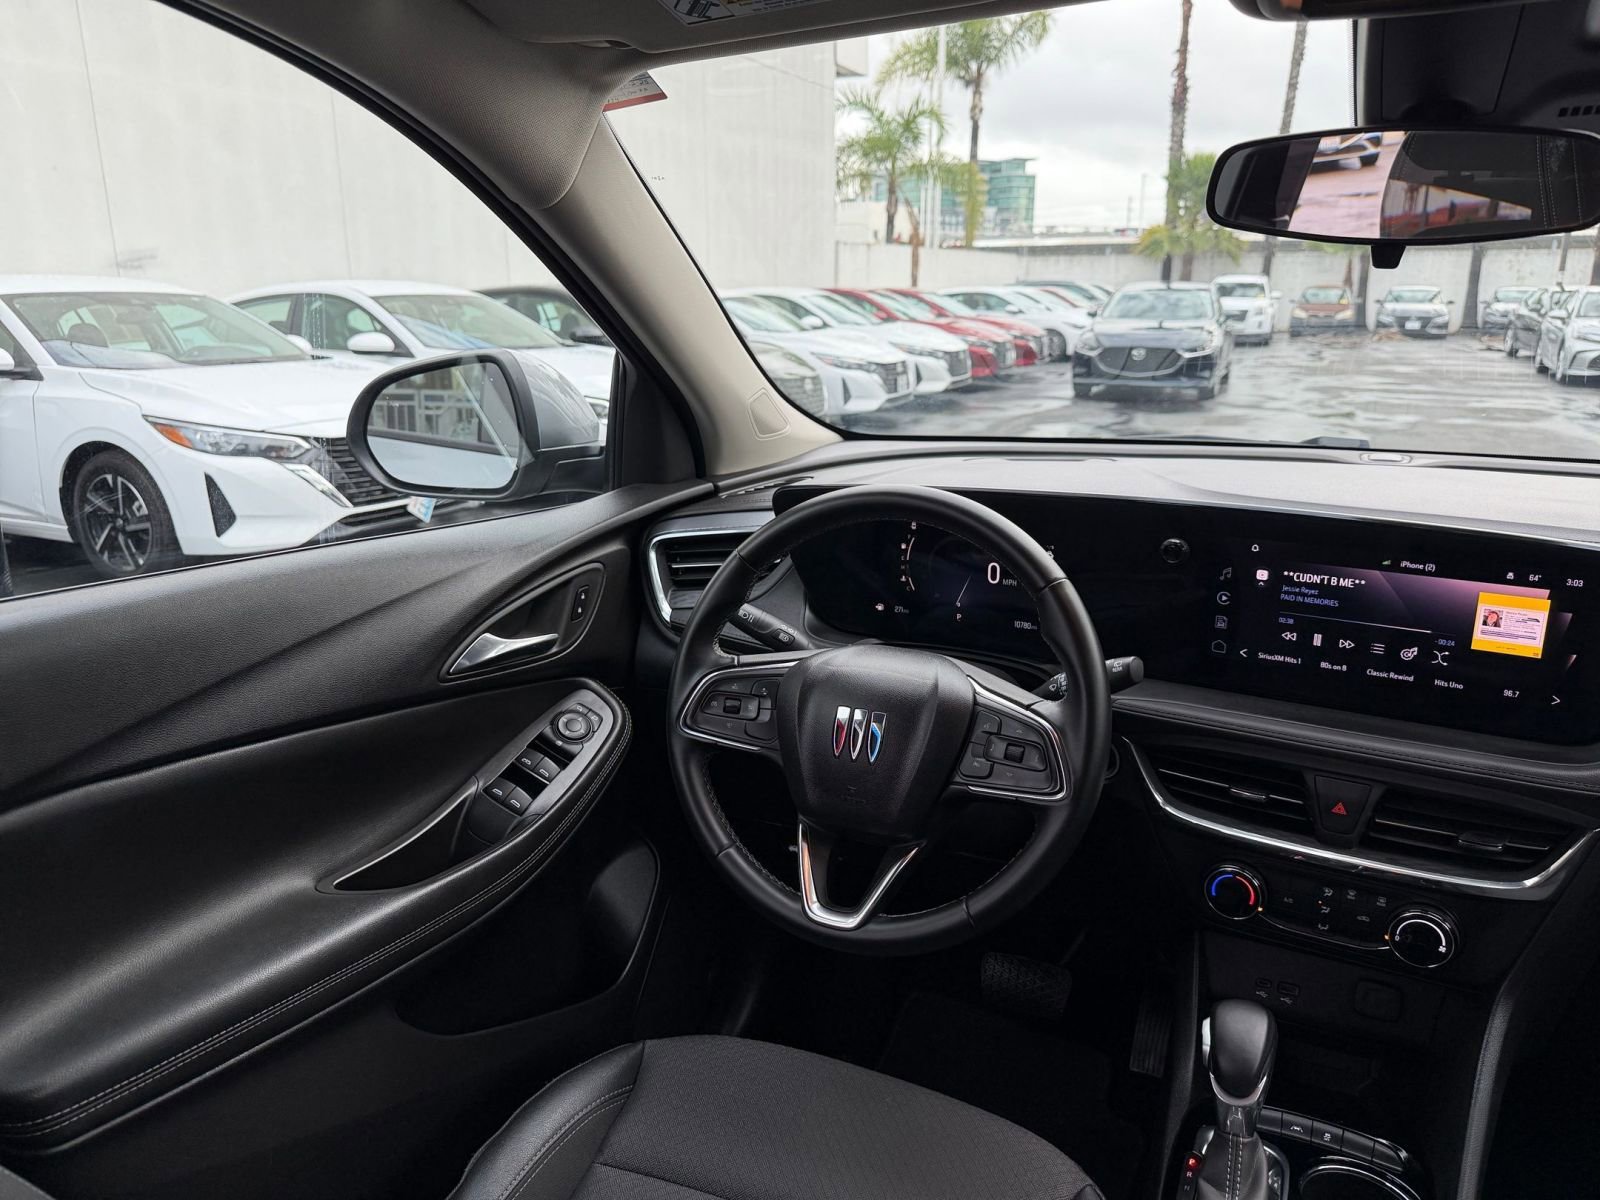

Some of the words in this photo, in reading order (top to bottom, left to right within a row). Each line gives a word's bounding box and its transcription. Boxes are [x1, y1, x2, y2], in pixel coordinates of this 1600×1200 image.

[1400, 560, 1424, 570] iPhone
[1425, 563, 1436, 573] (2)
[987, 562, 1000, 584] 0
[1002, 579, 1018, 588] MPH
[1331, 577, 1337, 586] B
[1566, 578, 1584, 587] 3:03
[1282, 585, 1301, 593] Jessie
[1301, 587, 1319, 595] Reyez
[1280, 593, 1296, 602] PAID
[1304, 596, 1339, 607] MEMORIES
[1257, 652, 1284, 662] SiriusXM
[1284, 656, 1297, 664] Hits
[1320, 661, 1332, 670] 80s
[1366, 668, 1388, 678] Classic
[1389, 672, 1414, 682] Rewind
[1434, 679, 1448, 688] Hits
[1449, 681, 1464, 690] Uno
[1504, 689, 1520, 698] 96.7
